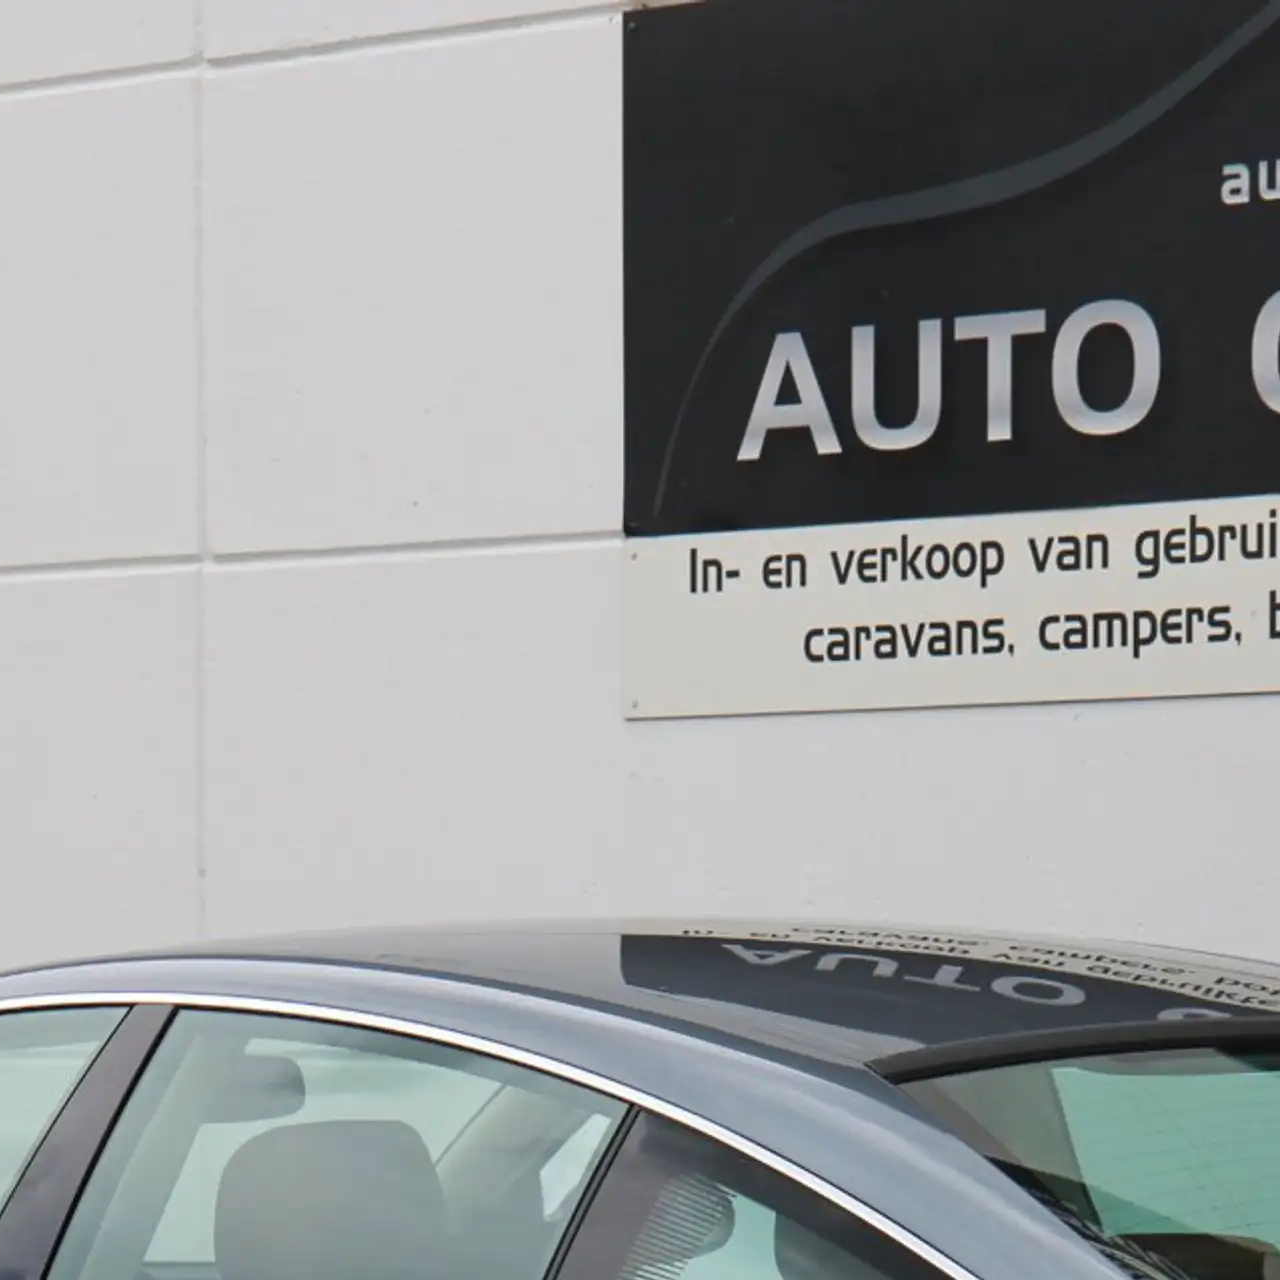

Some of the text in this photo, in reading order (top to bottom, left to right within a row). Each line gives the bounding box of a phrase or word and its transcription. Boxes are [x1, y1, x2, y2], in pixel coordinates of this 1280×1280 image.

[737, 300, 1161, 462] AUTO
[690, 548, 740, 593] In-
[762, 553, 807, 588] en
[830, 534, 1005, 588] verkoop
[1028, 534, 1109, 572] van
[803, 618, 1014, 663] caravans,
[1038, 605, 1243, 659] campers,
